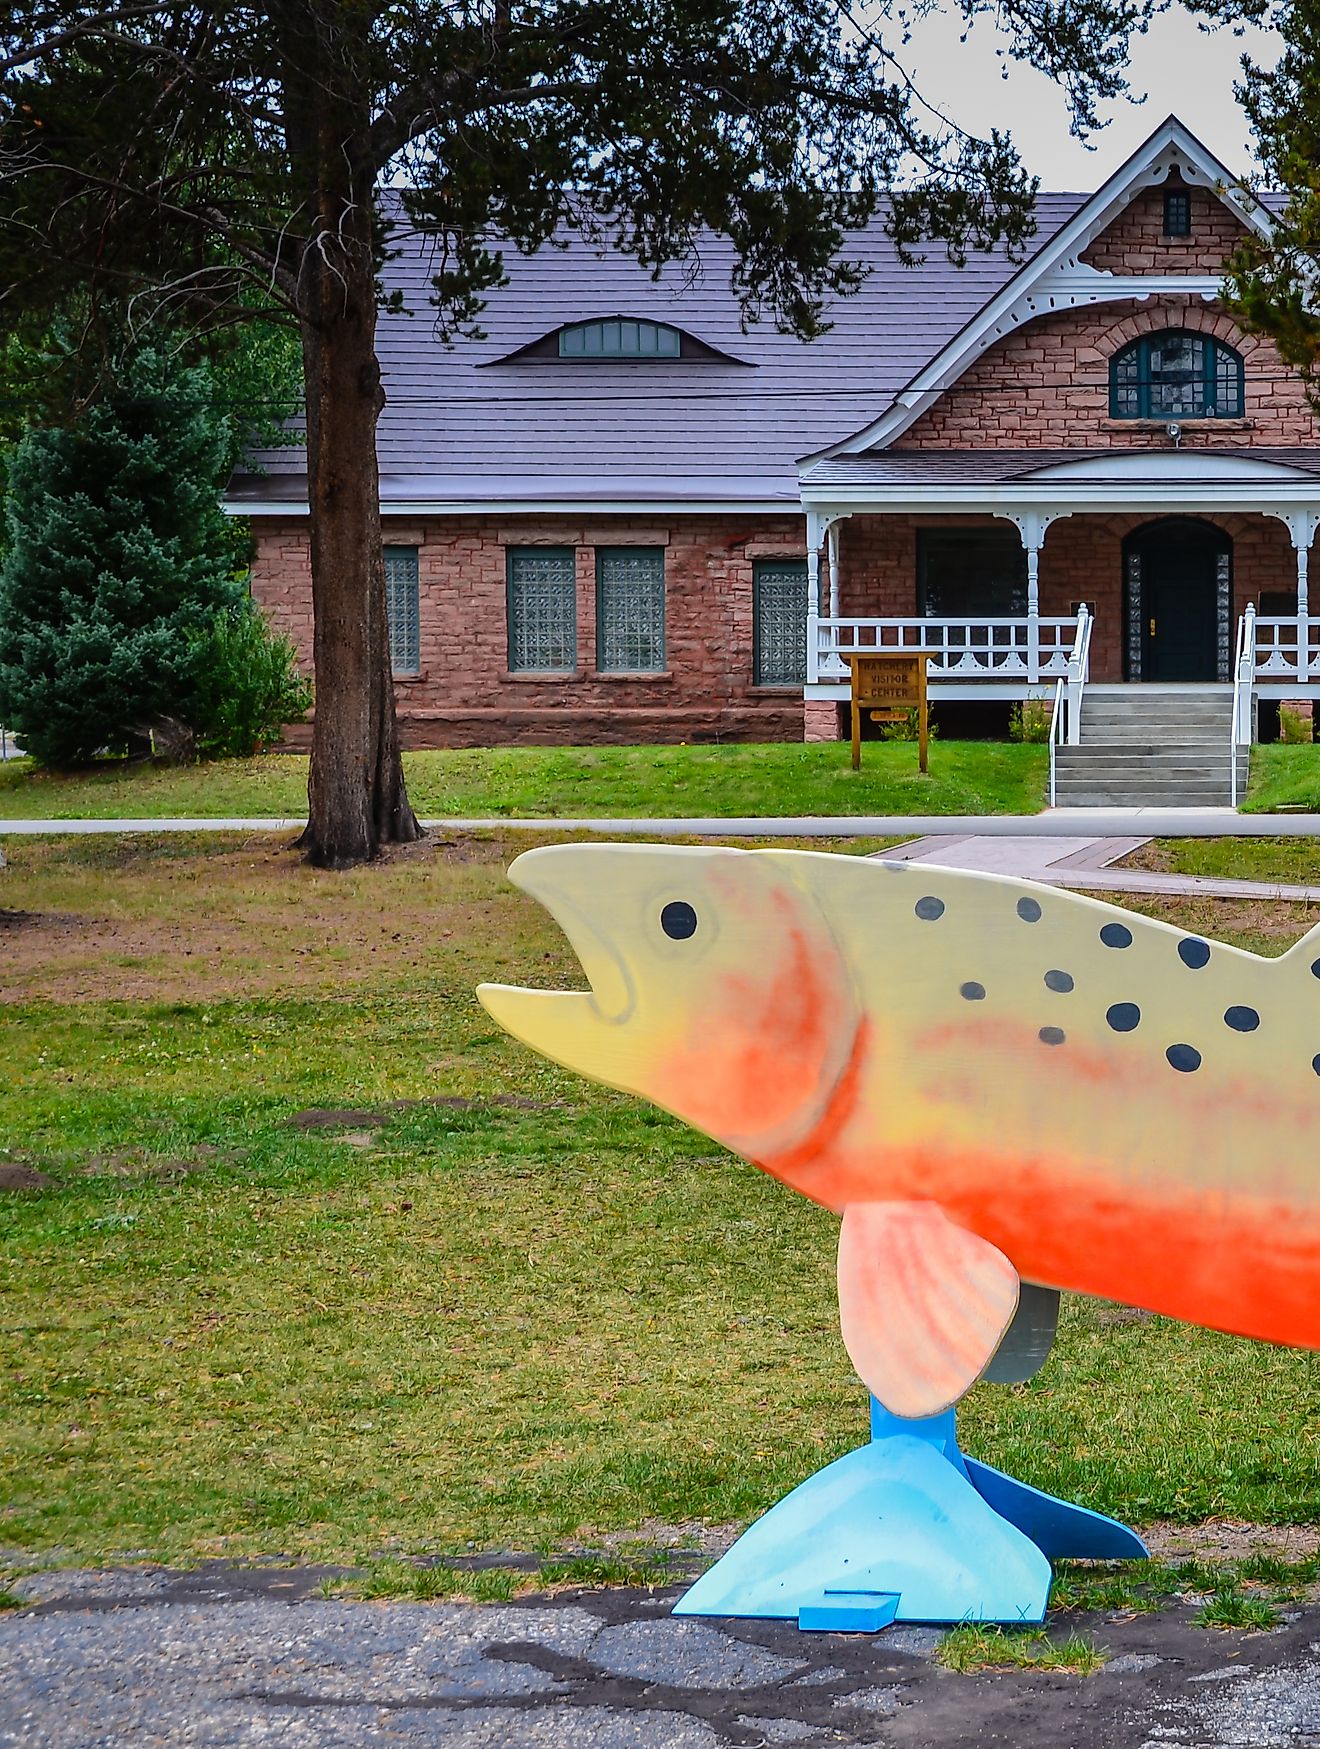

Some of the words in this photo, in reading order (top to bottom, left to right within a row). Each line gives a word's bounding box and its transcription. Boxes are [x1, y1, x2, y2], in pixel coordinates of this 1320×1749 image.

[864, 662, 914, 671] HATCHERY
[871, 674, 908, 684] VISITOR
[871, 688, 908, 697] CENTER
